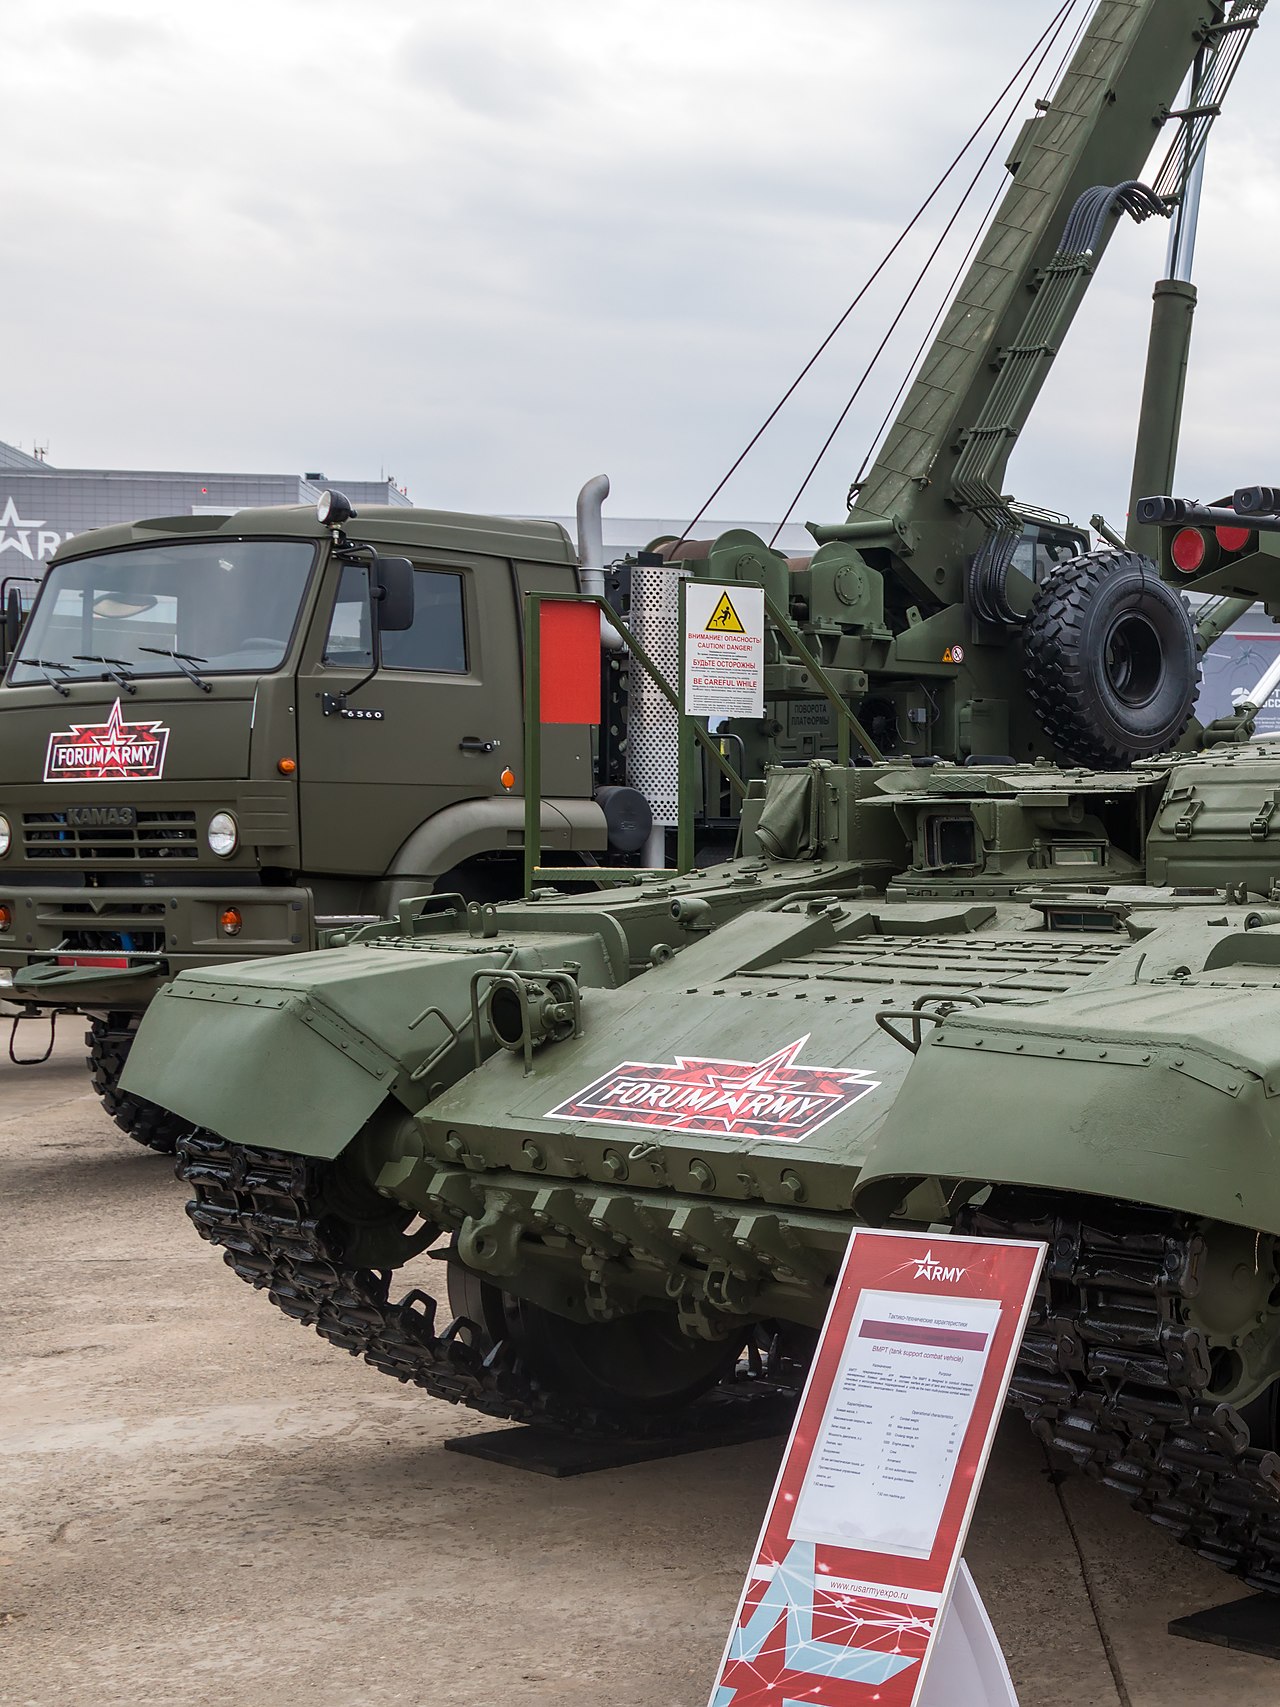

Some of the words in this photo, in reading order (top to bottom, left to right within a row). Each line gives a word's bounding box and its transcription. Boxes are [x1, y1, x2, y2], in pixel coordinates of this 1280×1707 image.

[688, 633, 724, 641] ВНИМАНИЕ!
[724, 635, 762, 644] ОПАСНОСТЬ!
[697, 642, 726, 650] CAUTION!
[726, 644, 753, 652] DANGER!
[692, 658, 716, 668] БУДЬТЕ
[716, 660, 756, 669] ОСТОРОЖНЫ
[703, 678, 735, 687] CAREFUL
[735, 680, 757, 688] WHILE
[794, 704, 827, 713] ПОВОРОТА
[347, 710, 382, 718] 6560
[791, 716, 830, 726] ПЛАТФОРМЫ
[913, 1249, 966, 1283] ARMY
[871, 1345, 889, 1353] BMPT
[889, 1347, 902, 1356] (tank
[902, 1350, 923, 1359] support
[923, 1352, 943, 1360] combat
[943, 1354, 965, 1363] vehicle)
[829, 1580, 909, 1600] www.rusarmyexpo.ru
